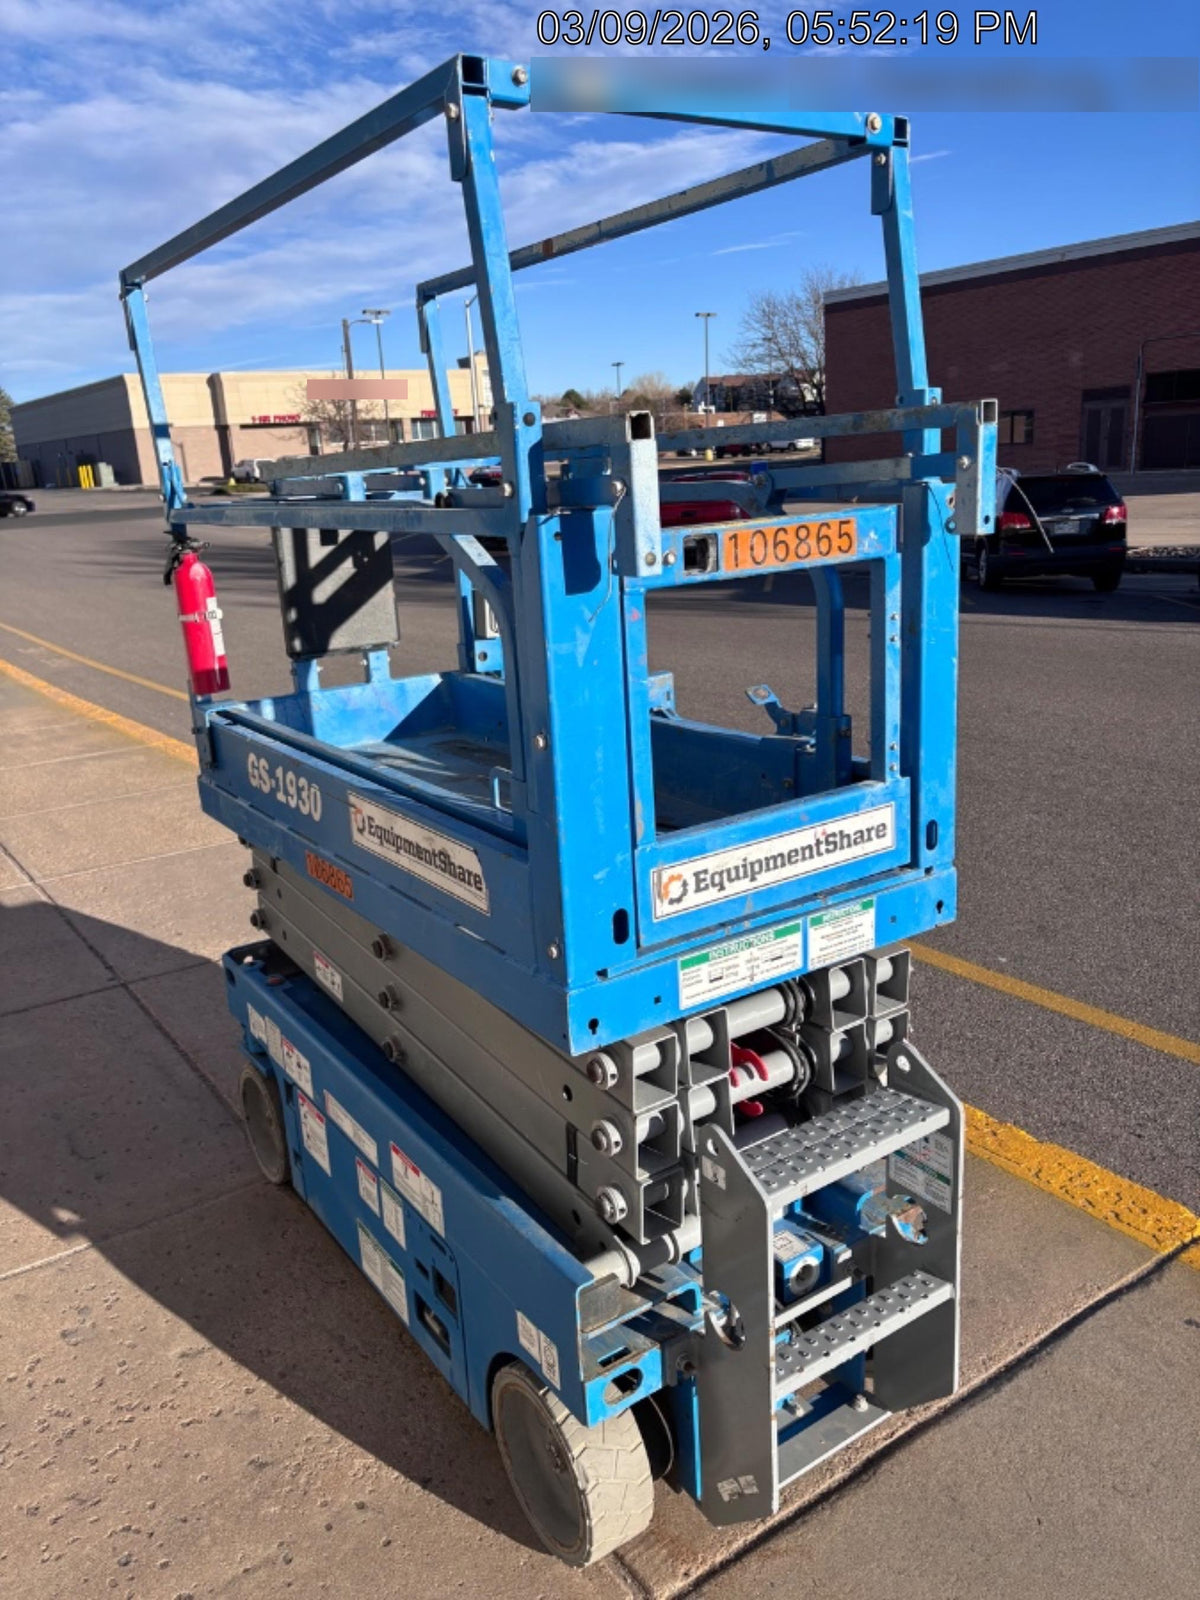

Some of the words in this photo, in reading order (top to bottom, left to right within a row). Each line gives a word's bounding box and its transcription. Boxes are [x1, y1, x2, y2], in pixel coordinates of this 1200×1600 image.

[727, 519, 853, 568] 106865
[247, 752, 321, 822] GS-1930
[366, 814, 483, 892] EquipmentShare
[692, 821, 888, 894] EquipmentShare
